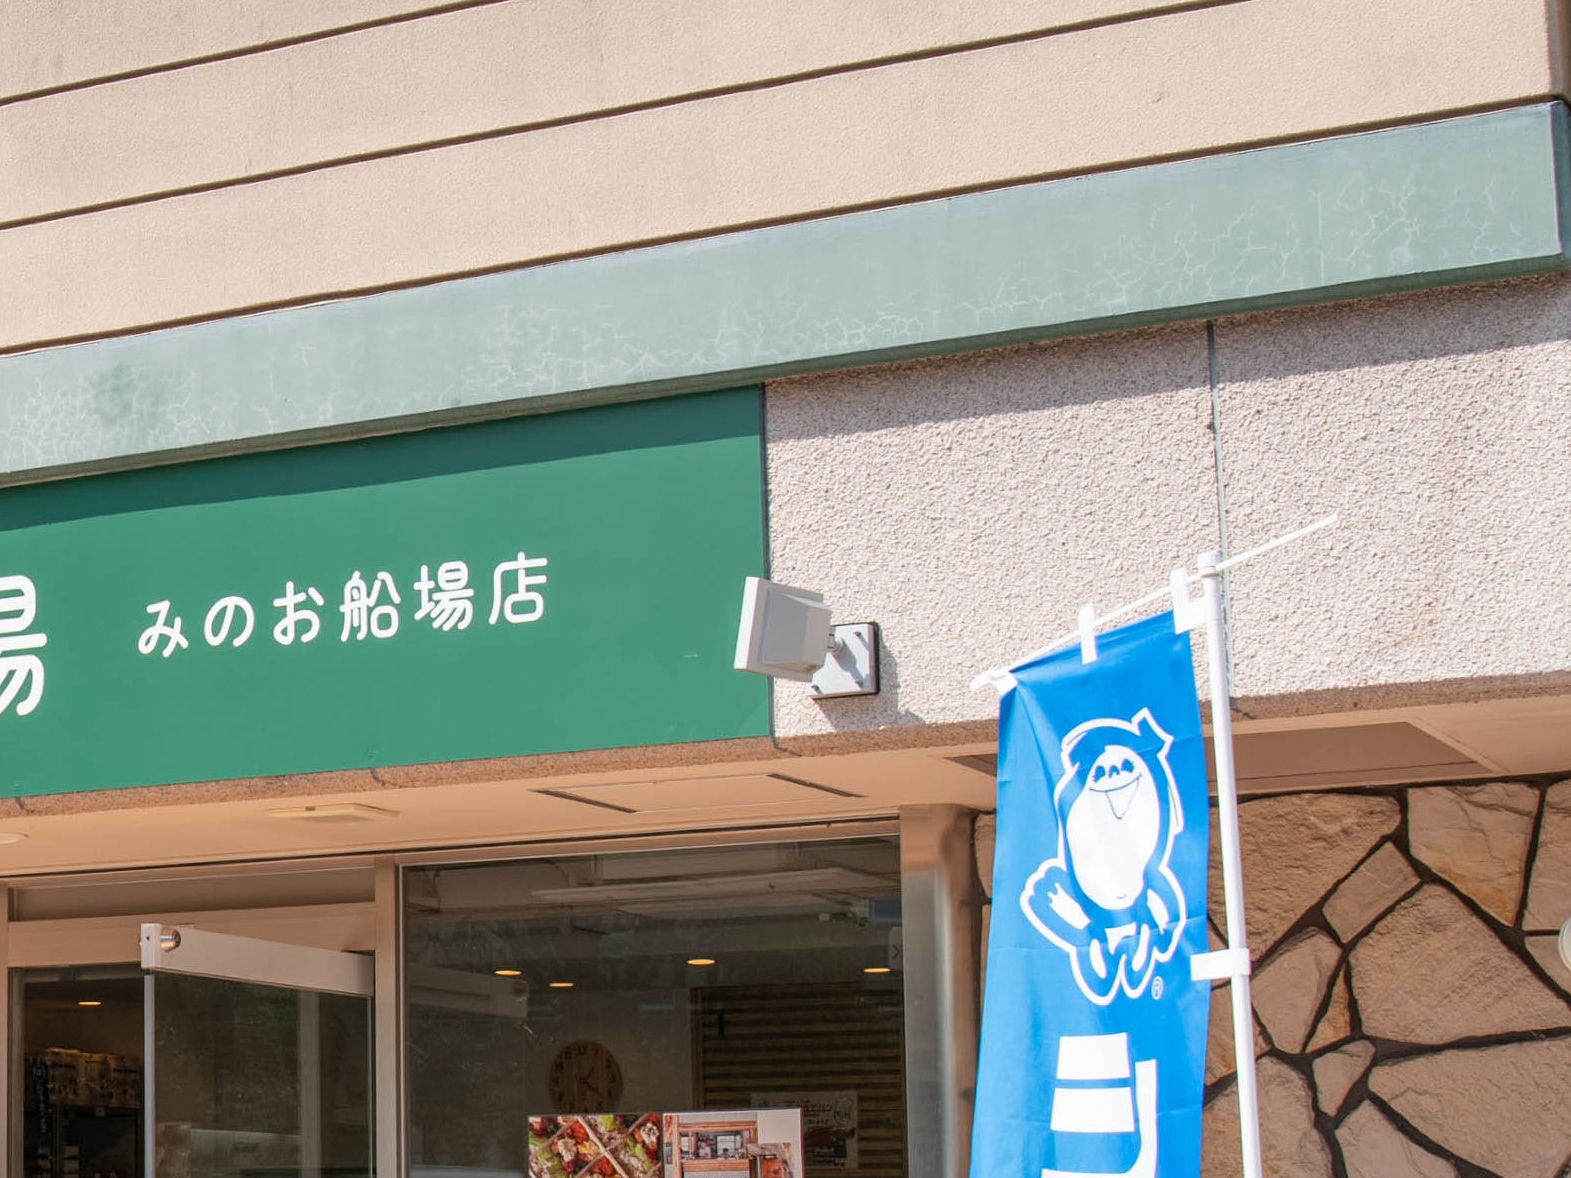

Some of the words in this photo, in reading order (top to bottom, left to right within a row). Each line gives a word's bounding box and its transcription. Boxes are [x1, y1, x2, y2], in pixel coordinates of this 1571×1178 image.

[137, 551, 549, 658] みのお船場店
